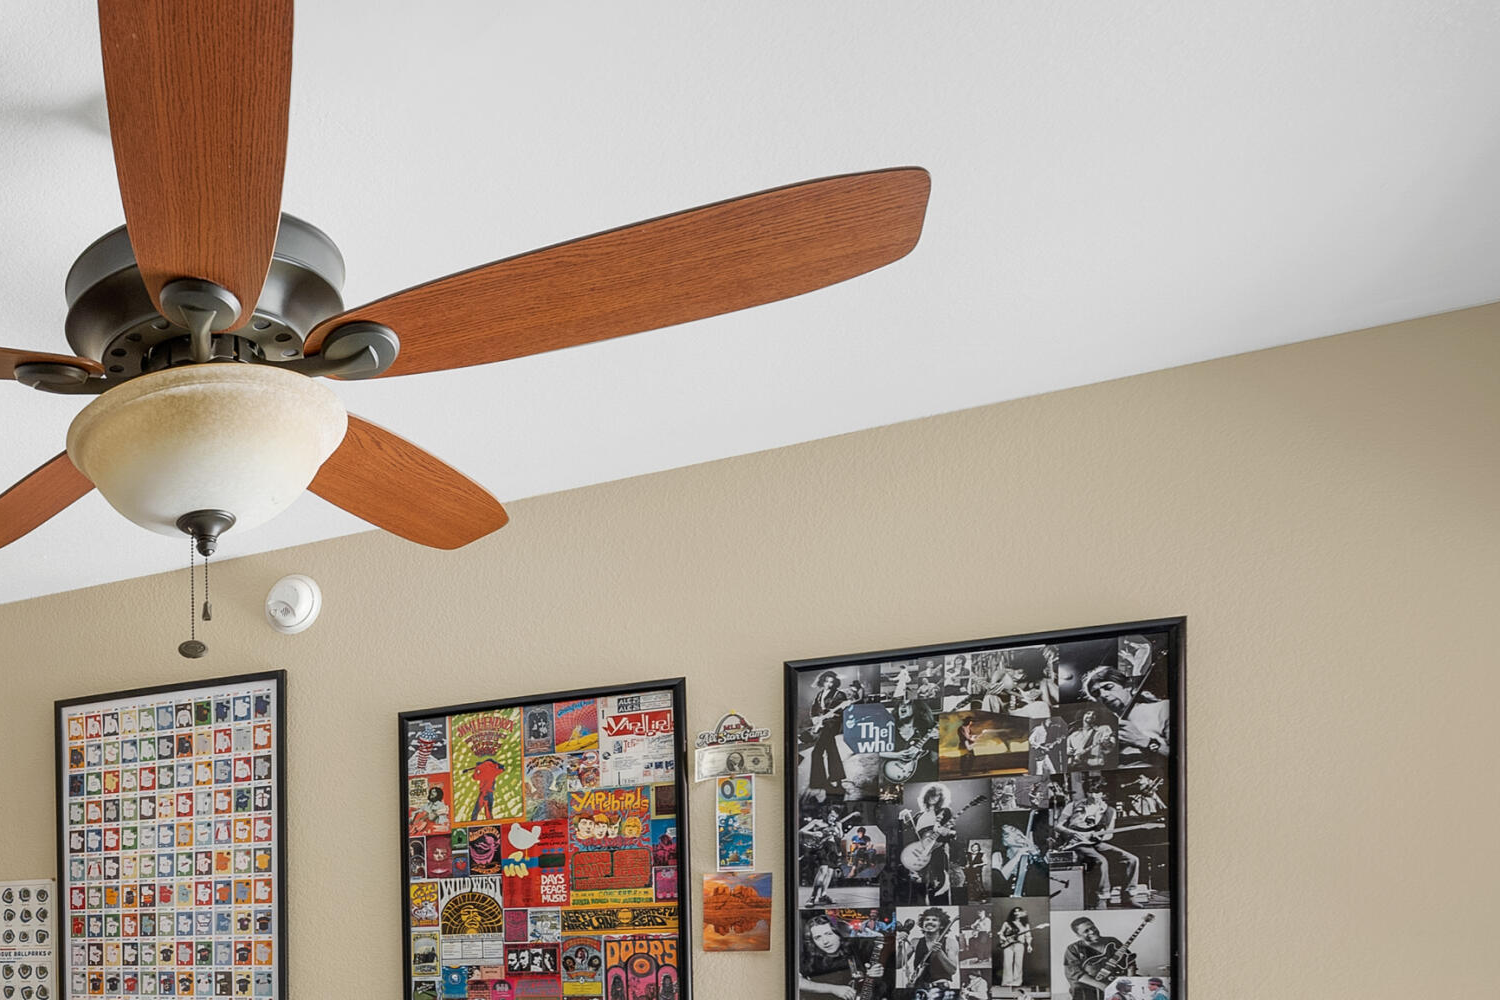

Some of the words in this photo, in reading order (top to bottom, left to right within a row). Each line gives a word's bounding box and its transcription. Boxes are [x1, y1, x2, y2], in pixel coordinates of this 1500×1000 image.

[741, 729, 769, 741] Game
[857, 721, 889, 740] The
[541, 874, 565, 885] DAYS
[441, 877, 471, 900] WILD
[471, 875, 502, 894] WEST
[541, 884, 567, 895] PEACE
[542, 894, 567, 904] MUSIC
[606, 940, 678, 969] DOORS
